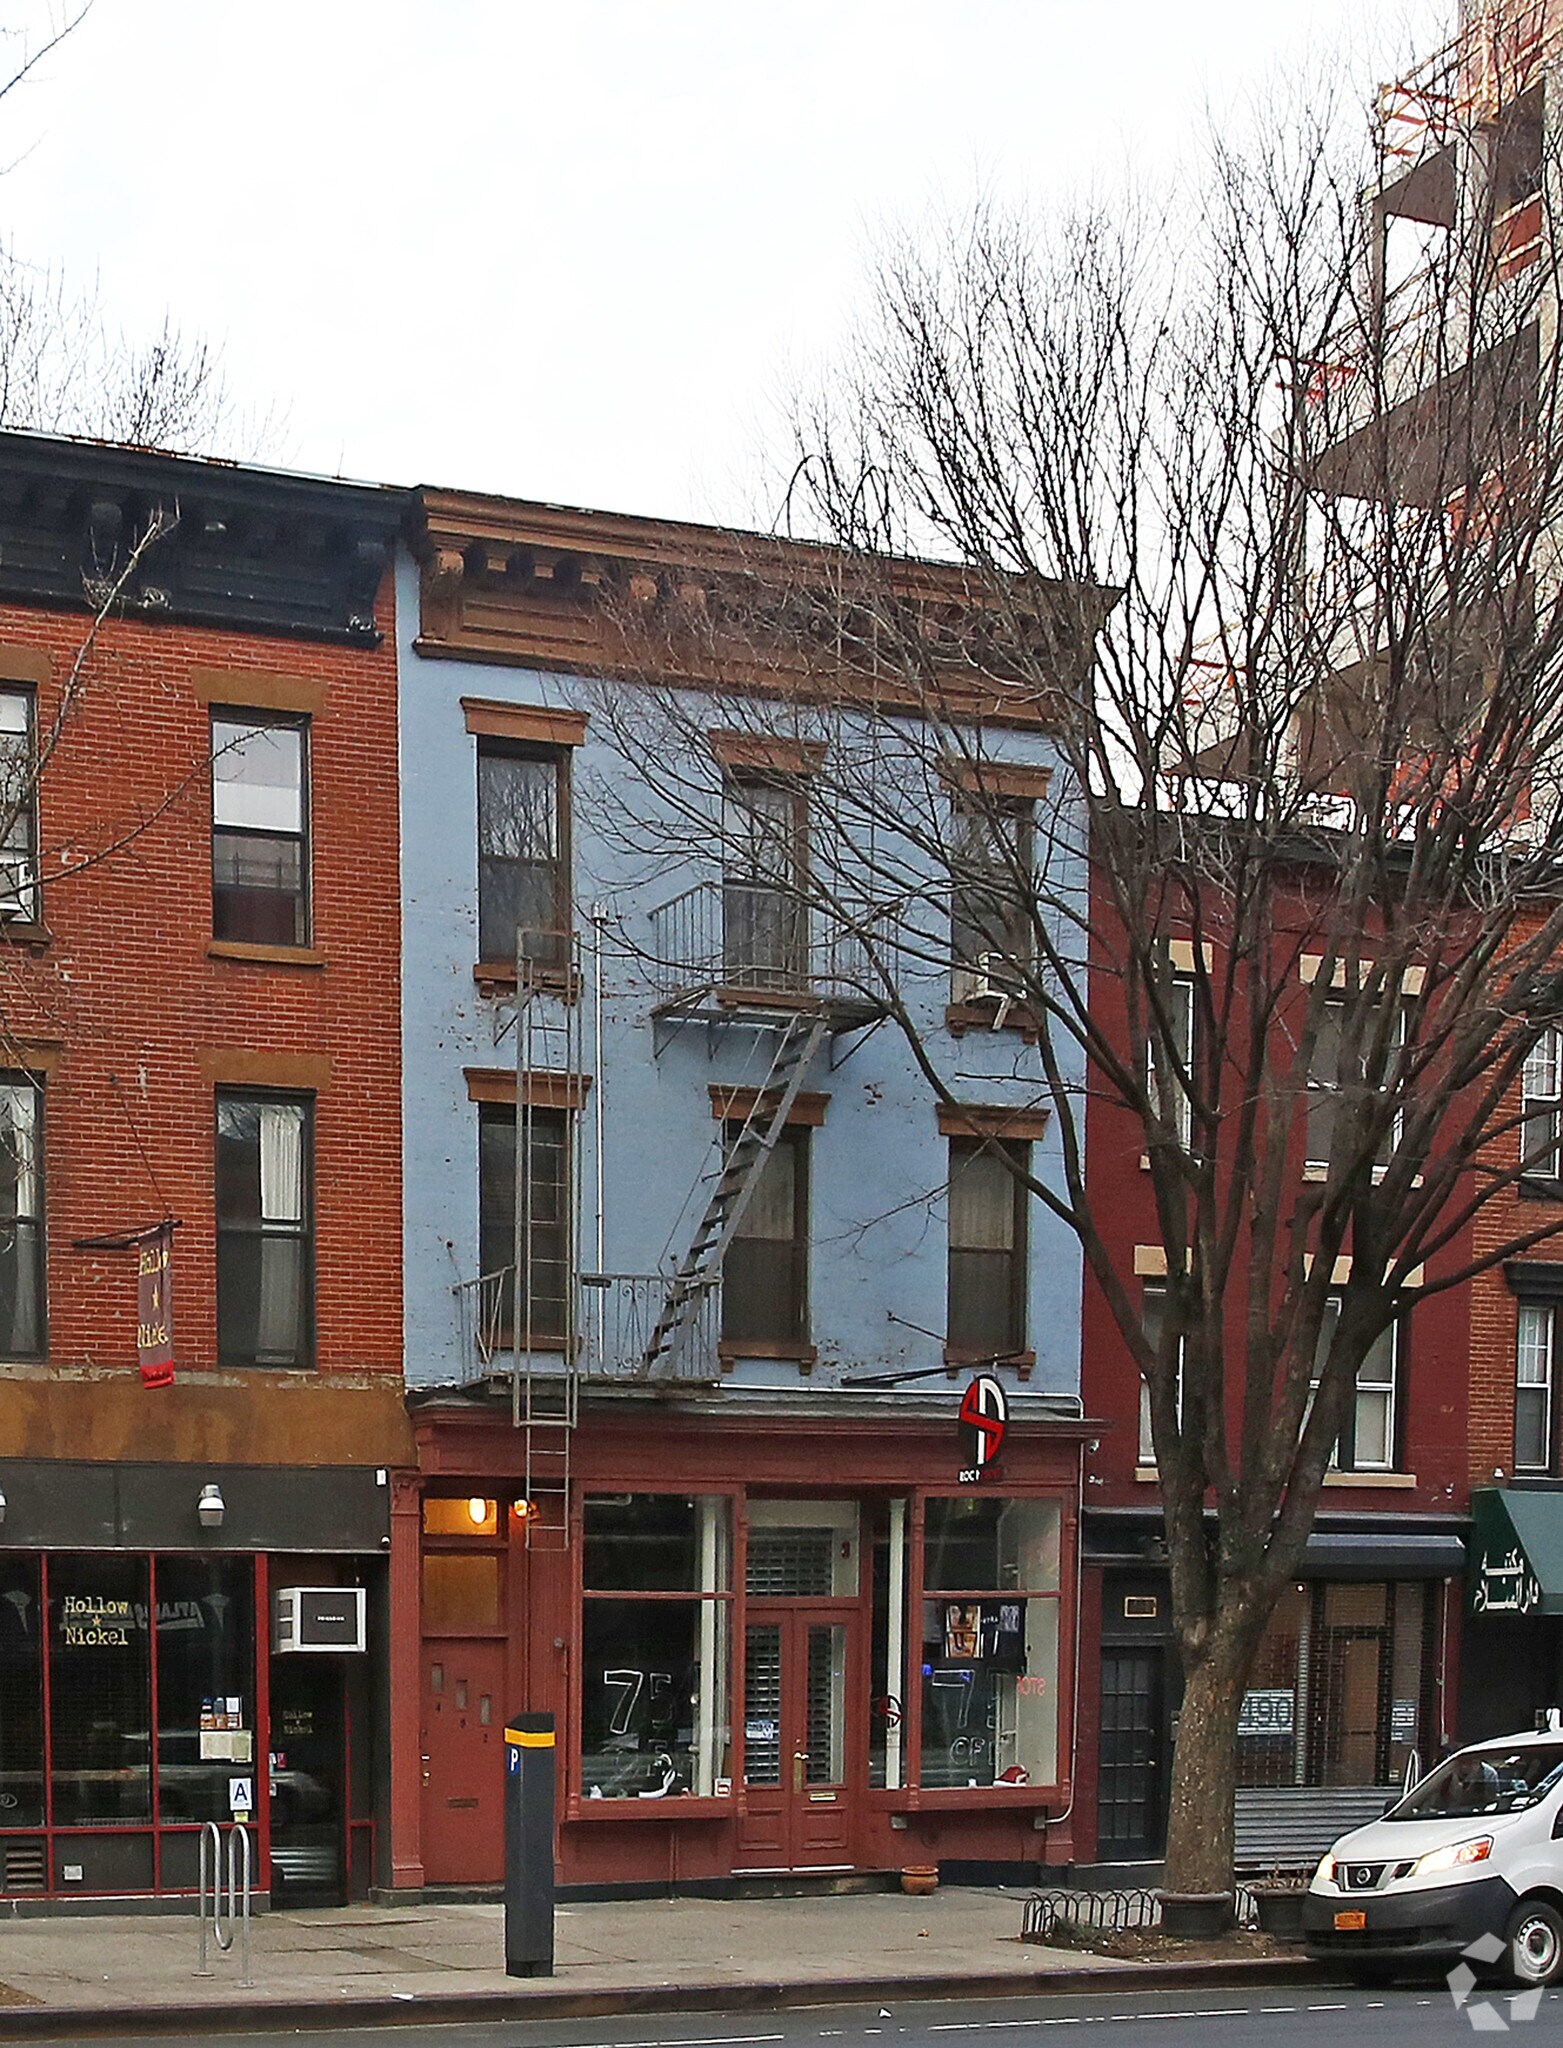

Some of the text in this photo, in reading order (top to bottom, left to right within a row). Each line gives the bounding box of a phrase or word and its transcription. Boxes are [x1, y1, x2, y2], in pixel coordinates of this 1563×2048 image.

[64, 1596, 129, 1614] Hollow
[65, 1627, 129, 1646] Nickel
[510, 1748, 519, 1772] P
[233, 1782, 248, 1802] A
